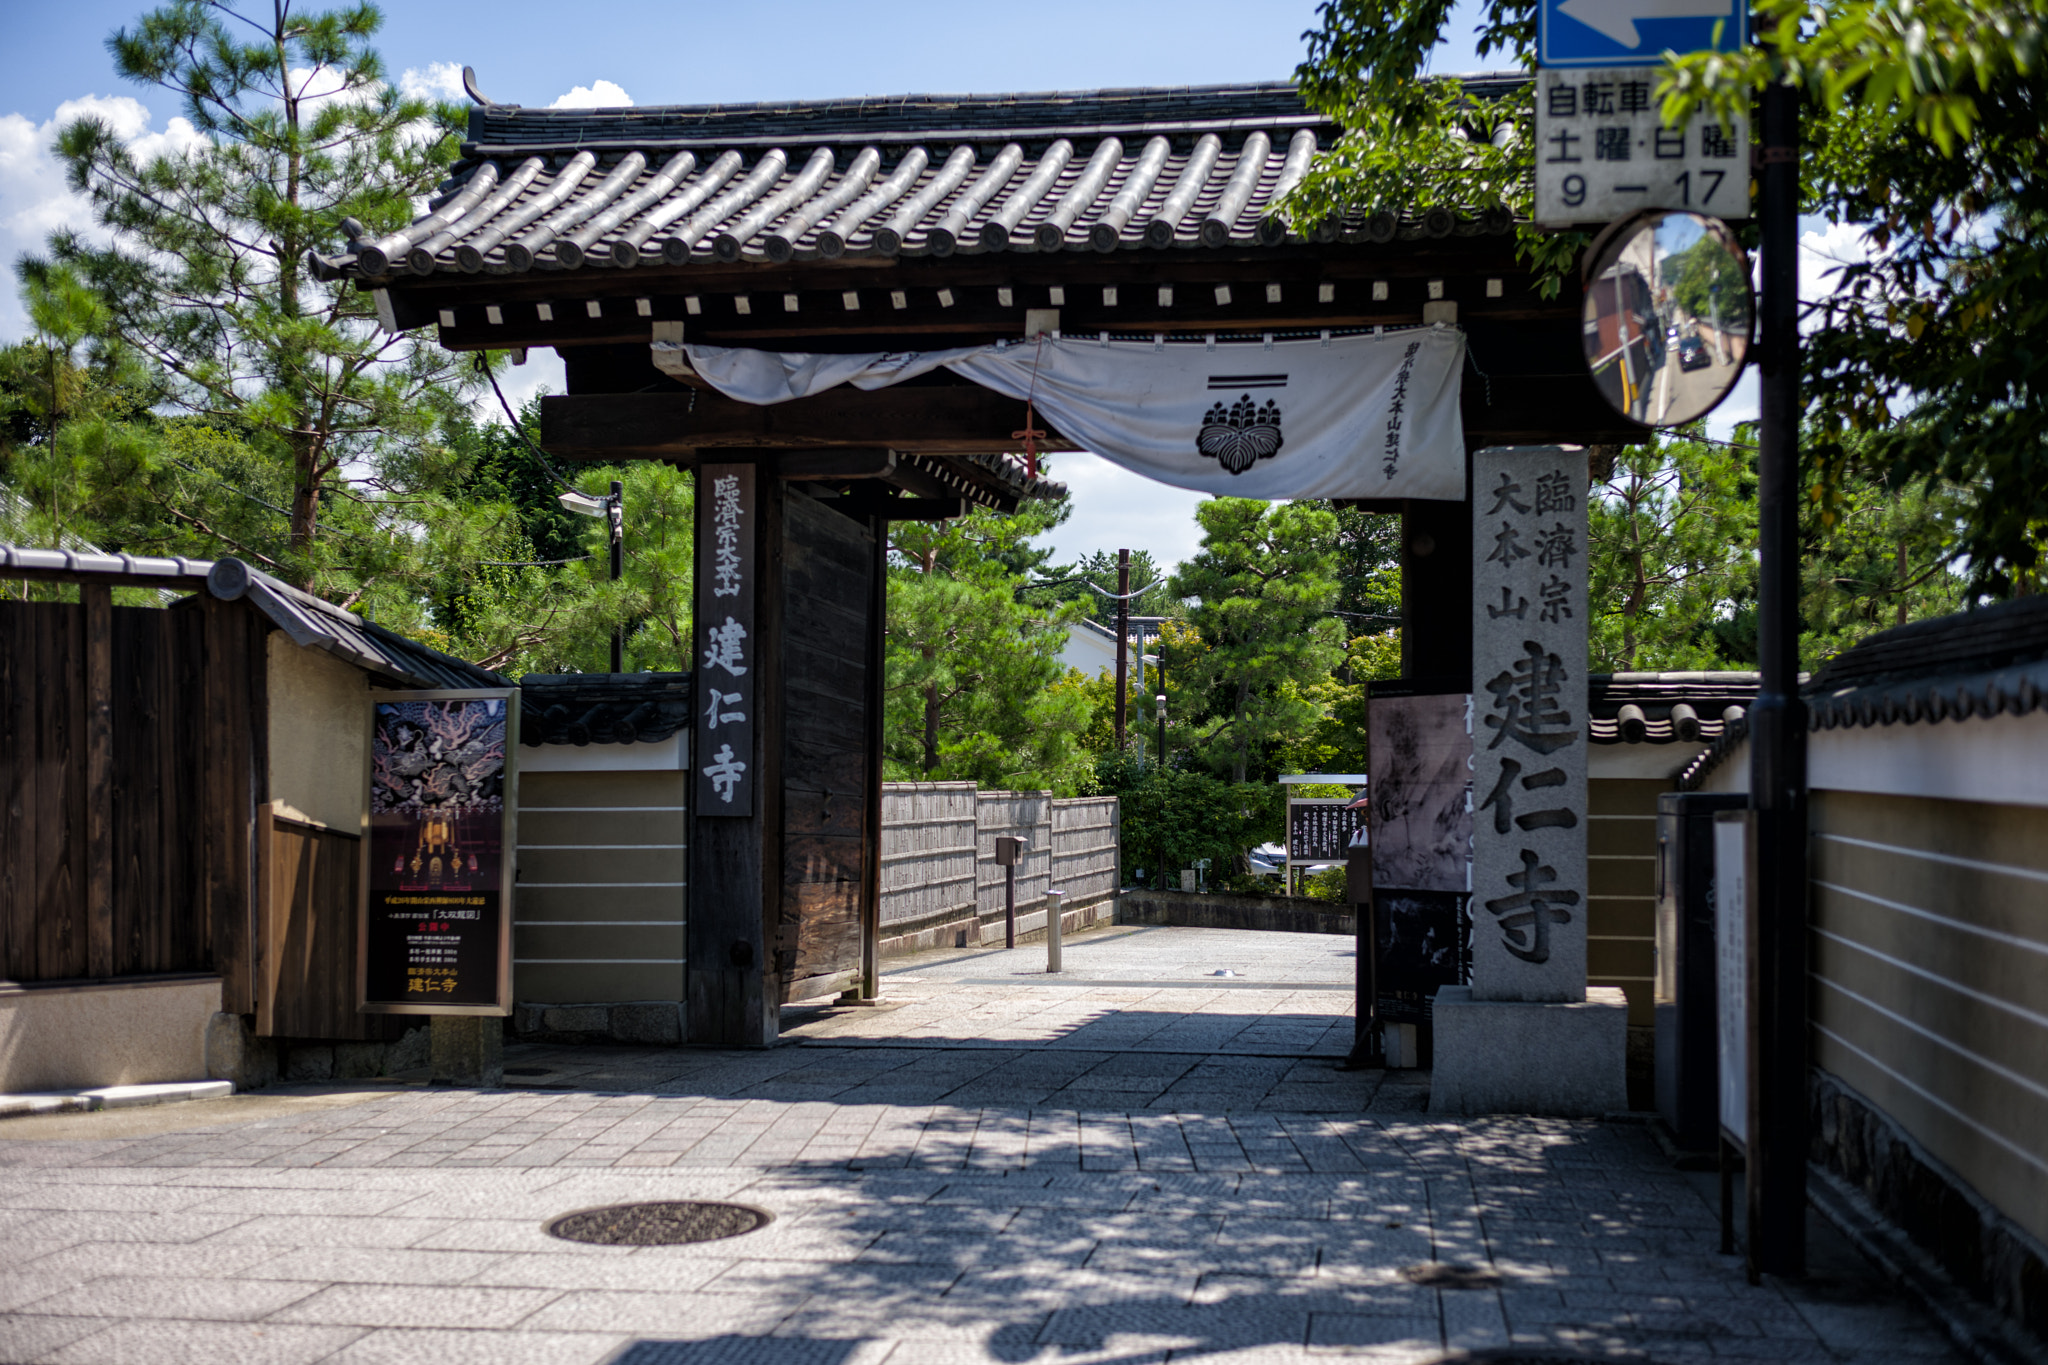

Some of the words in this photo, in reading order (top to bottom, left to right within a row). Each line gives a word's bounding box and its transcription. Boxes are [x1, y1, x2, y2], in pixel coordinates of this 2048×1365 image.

[1485, 472, 1532, 620] 大本山
[703, 616, 748, 803] 建仁寺
[1477, 639, 1580, 964] 建仁寺
[407, 977, 458, 993] 建仁寺
